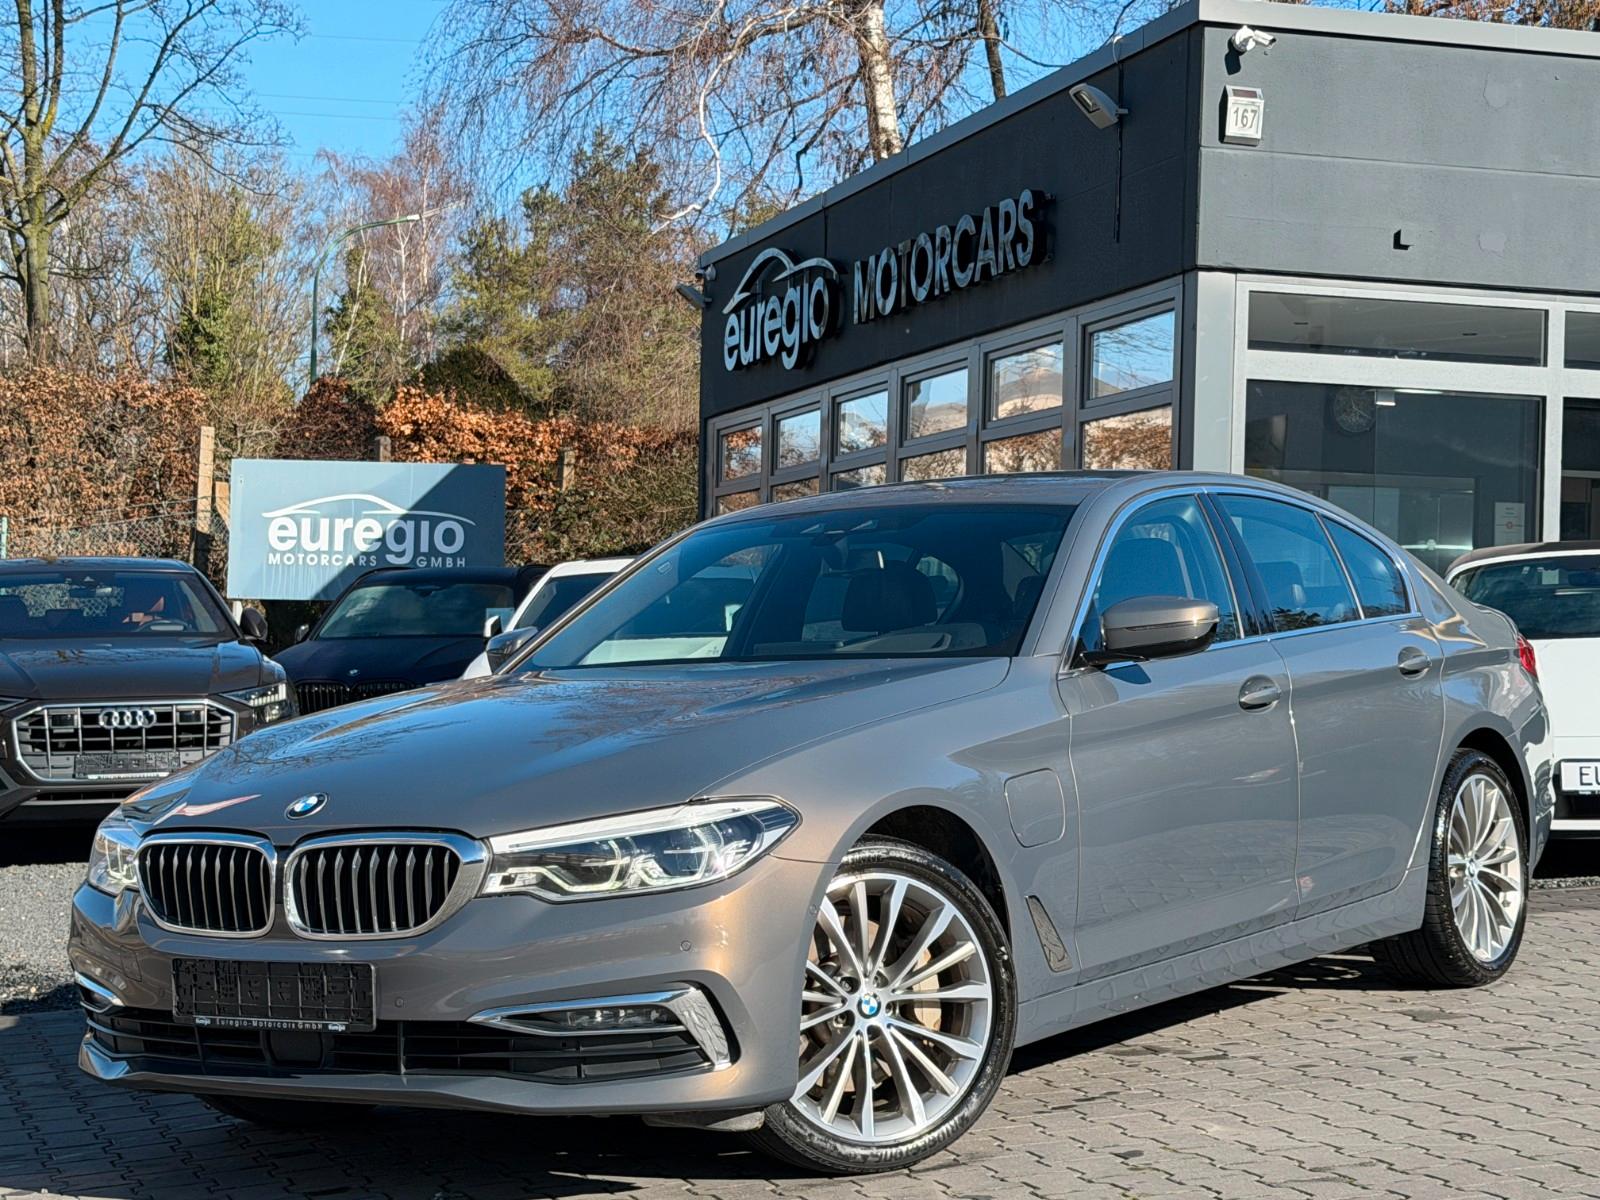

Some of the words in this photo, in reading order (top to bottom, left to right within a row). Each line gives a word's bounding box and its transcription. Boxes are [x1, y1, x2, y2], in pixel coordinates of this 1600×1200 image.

[1233, 107, 1258, 129] 167
[724, 276, 829, 371] euregio
[853, 189, 1034, 324] MOTORCARS
[268, 517, 465, 565] euregio
[268, 553, 377, 566] MOTORCARS
[416, 556, 465, 568] GMBH
